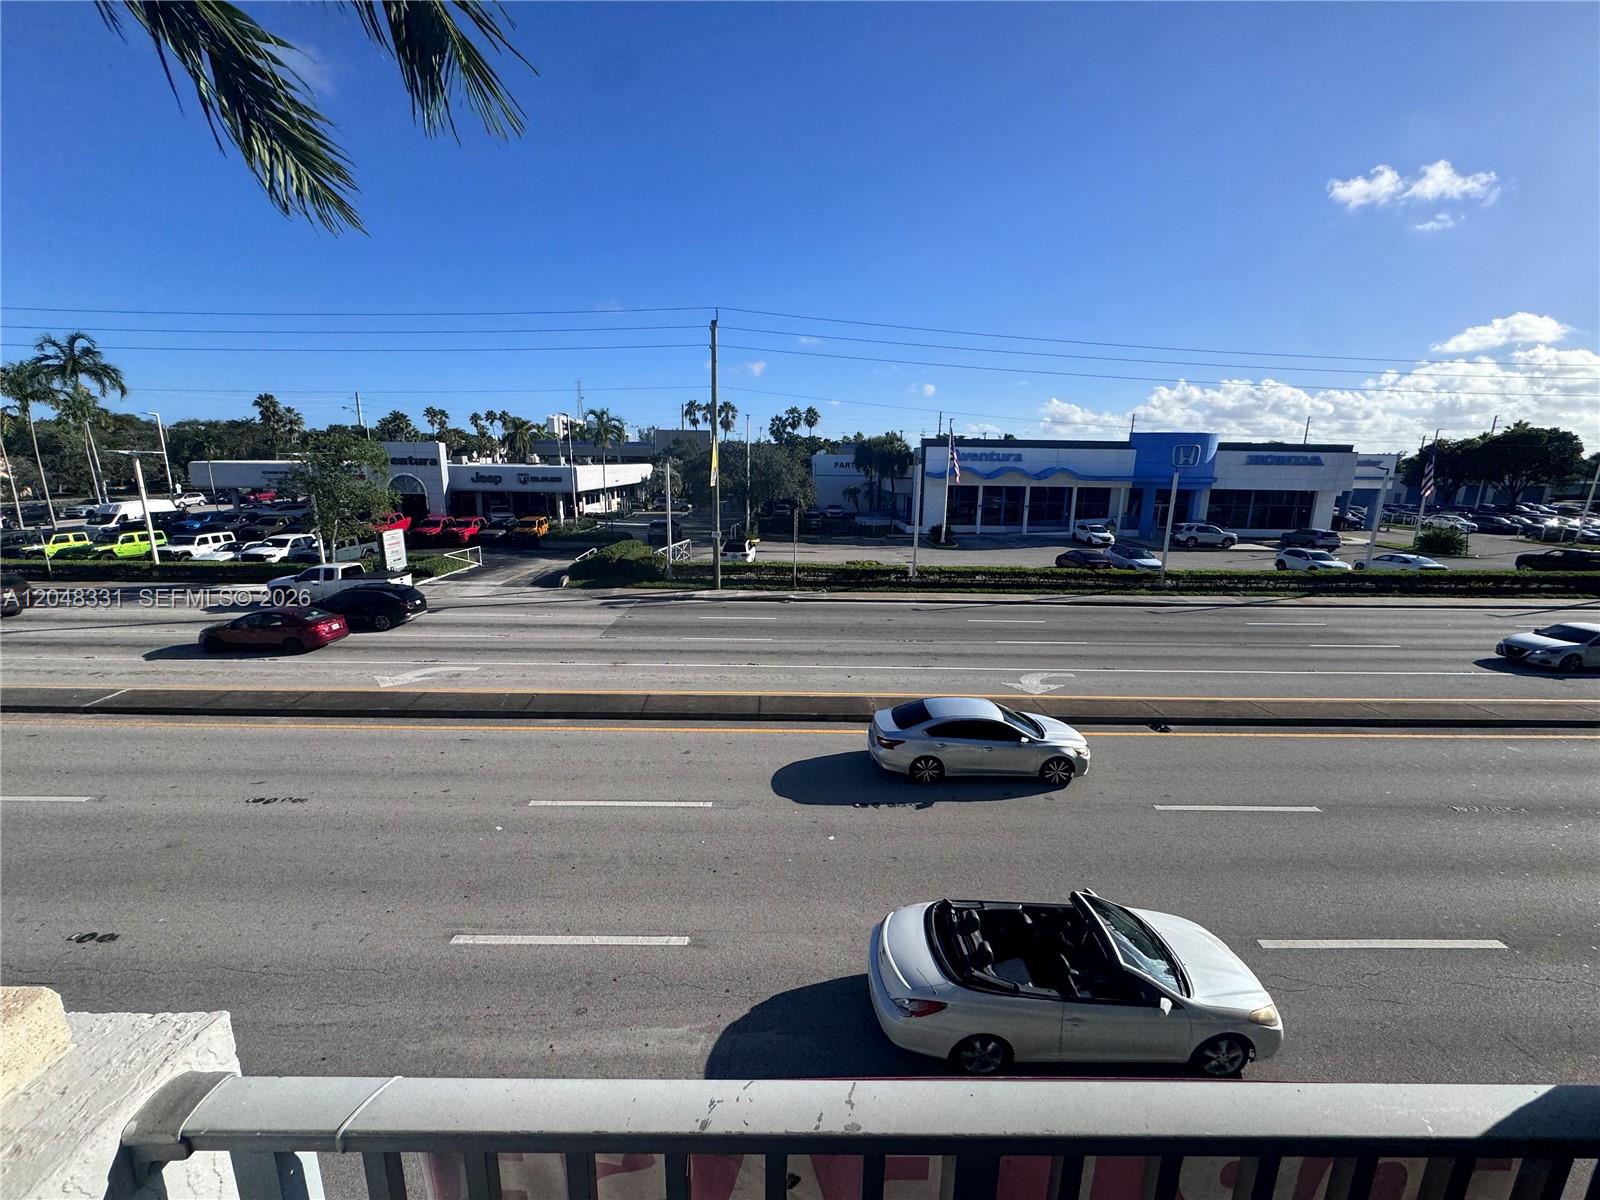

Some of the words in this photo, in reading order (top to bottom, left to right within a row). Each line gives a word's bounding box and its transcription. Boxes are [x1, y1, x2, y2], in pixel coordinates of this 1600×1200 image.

[390, 456, 438, 466] entura
[834, 461, 856, 469] PART
[1246, 455, 1325, 466] HONDA
[470, 472, 502, 486] Jeep
